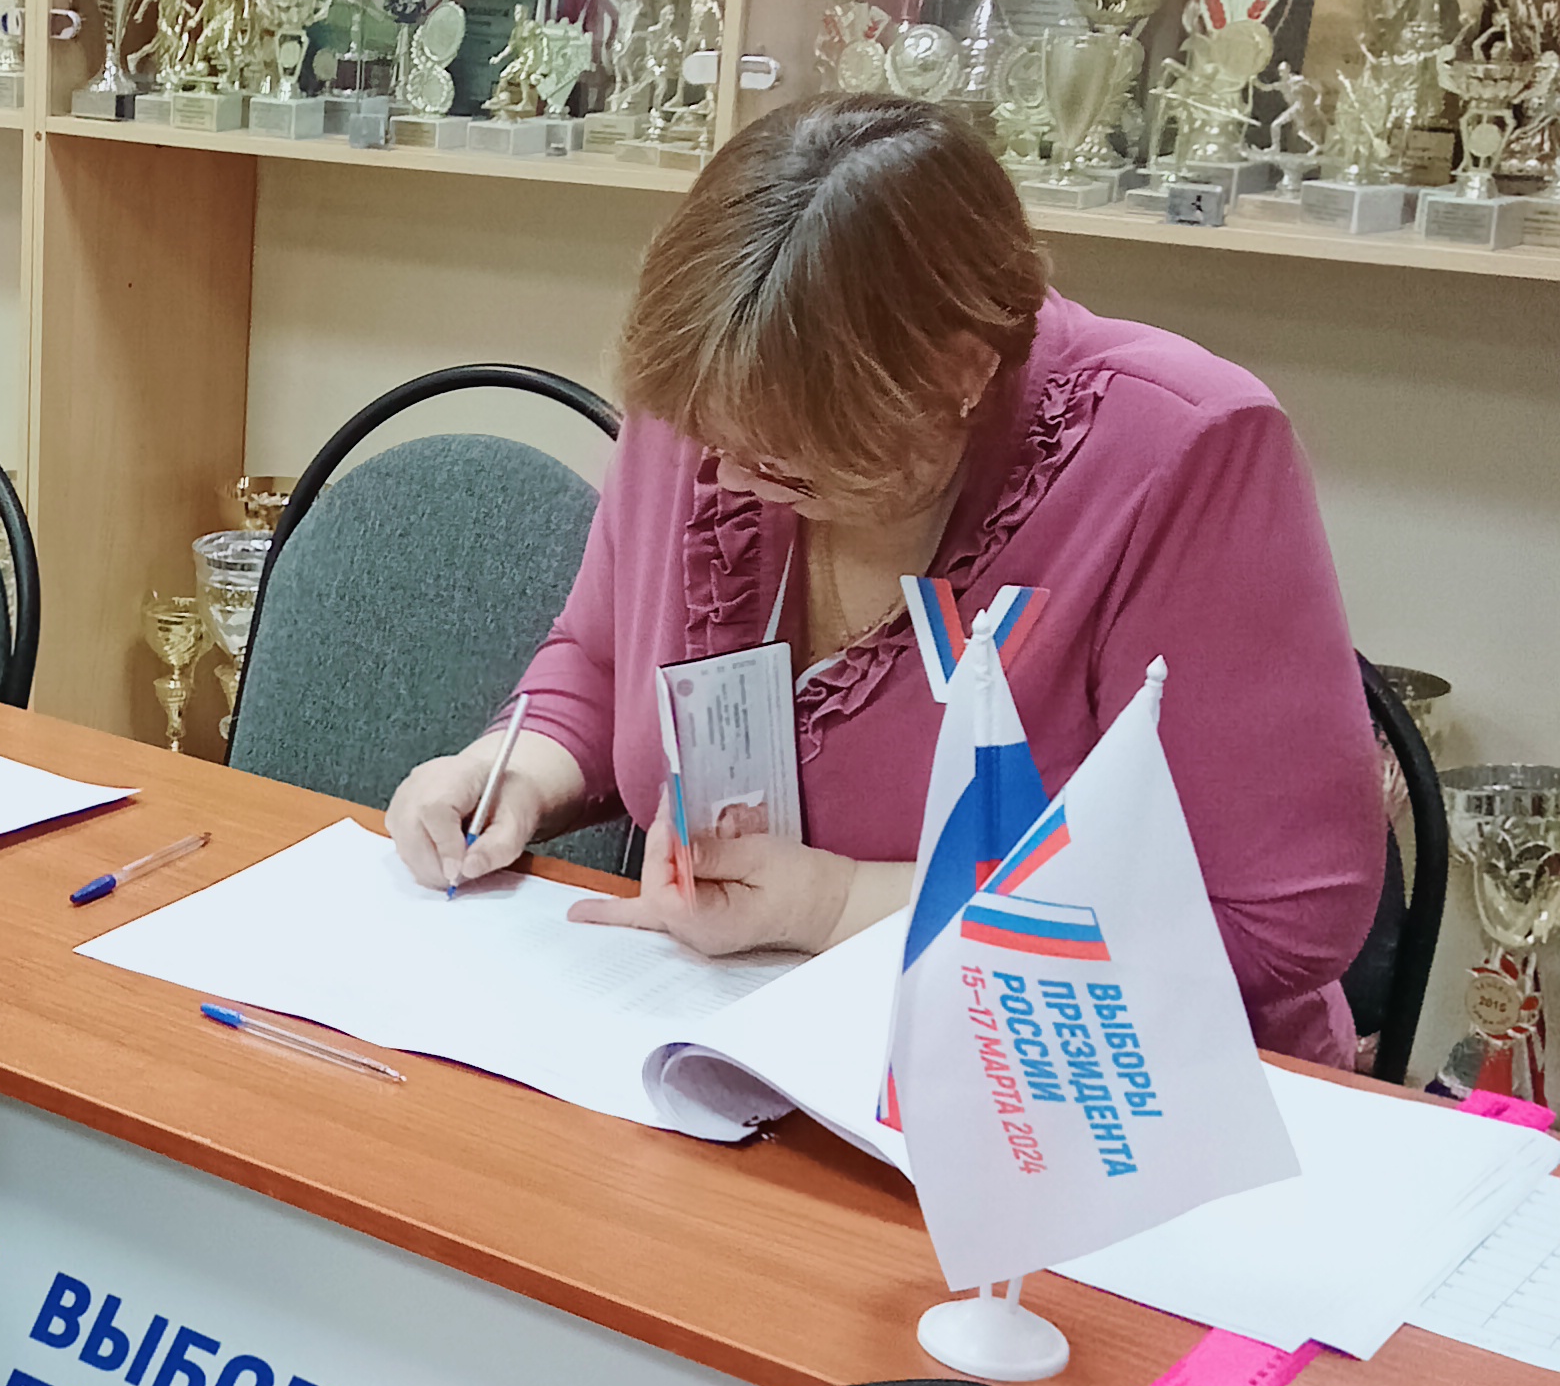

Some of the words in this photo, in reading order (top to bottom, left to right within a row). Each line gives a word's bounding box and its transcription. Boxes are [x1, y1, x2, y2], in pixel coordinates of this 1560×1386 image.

[974, 1034, 1026, 1115] МАРТА
[1001, 1119, 1048, 1174] 2024
[992, 970, 1067, 1102] РОССИИ
[1037, 979, 1138, 1177] ПРЕЗИДЕНТА
[1087, 982, 1163, 1117] ВЫБОРЫ
